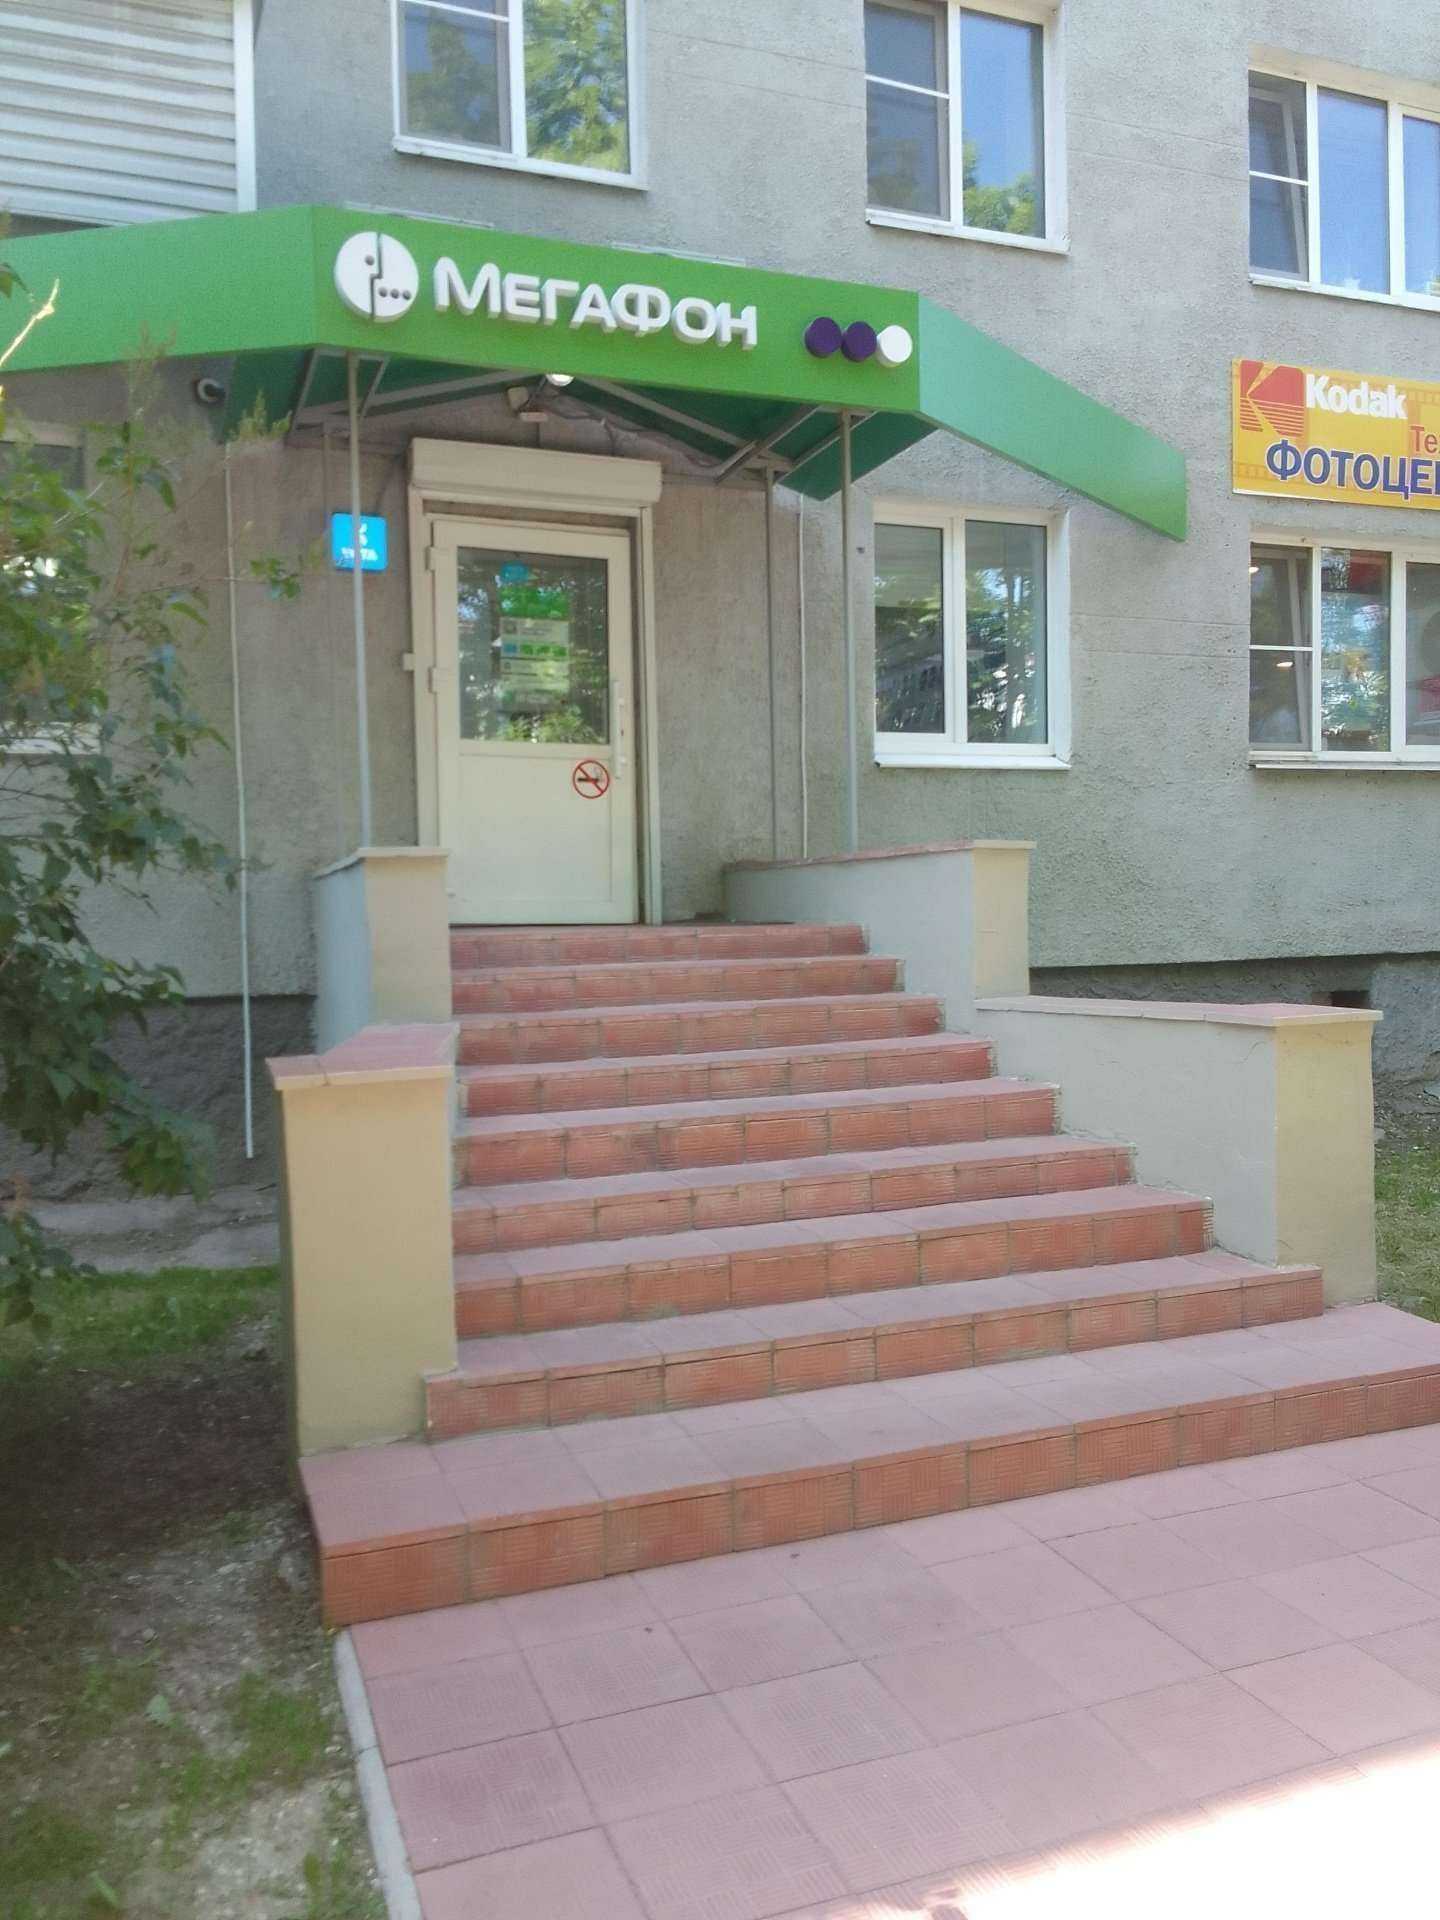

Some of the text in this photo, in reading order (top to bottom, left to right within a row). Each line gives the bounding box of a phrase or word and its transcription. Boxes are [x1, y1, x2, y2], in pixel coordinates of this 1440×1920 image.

[433, 256, 757, 350] МЕГАФОН
[1306, 374, 1407, 419] Kodak
[1410, 425, 1440, 454] Те
[1266, 439, 1440, 500] ФОТОЦЕ
